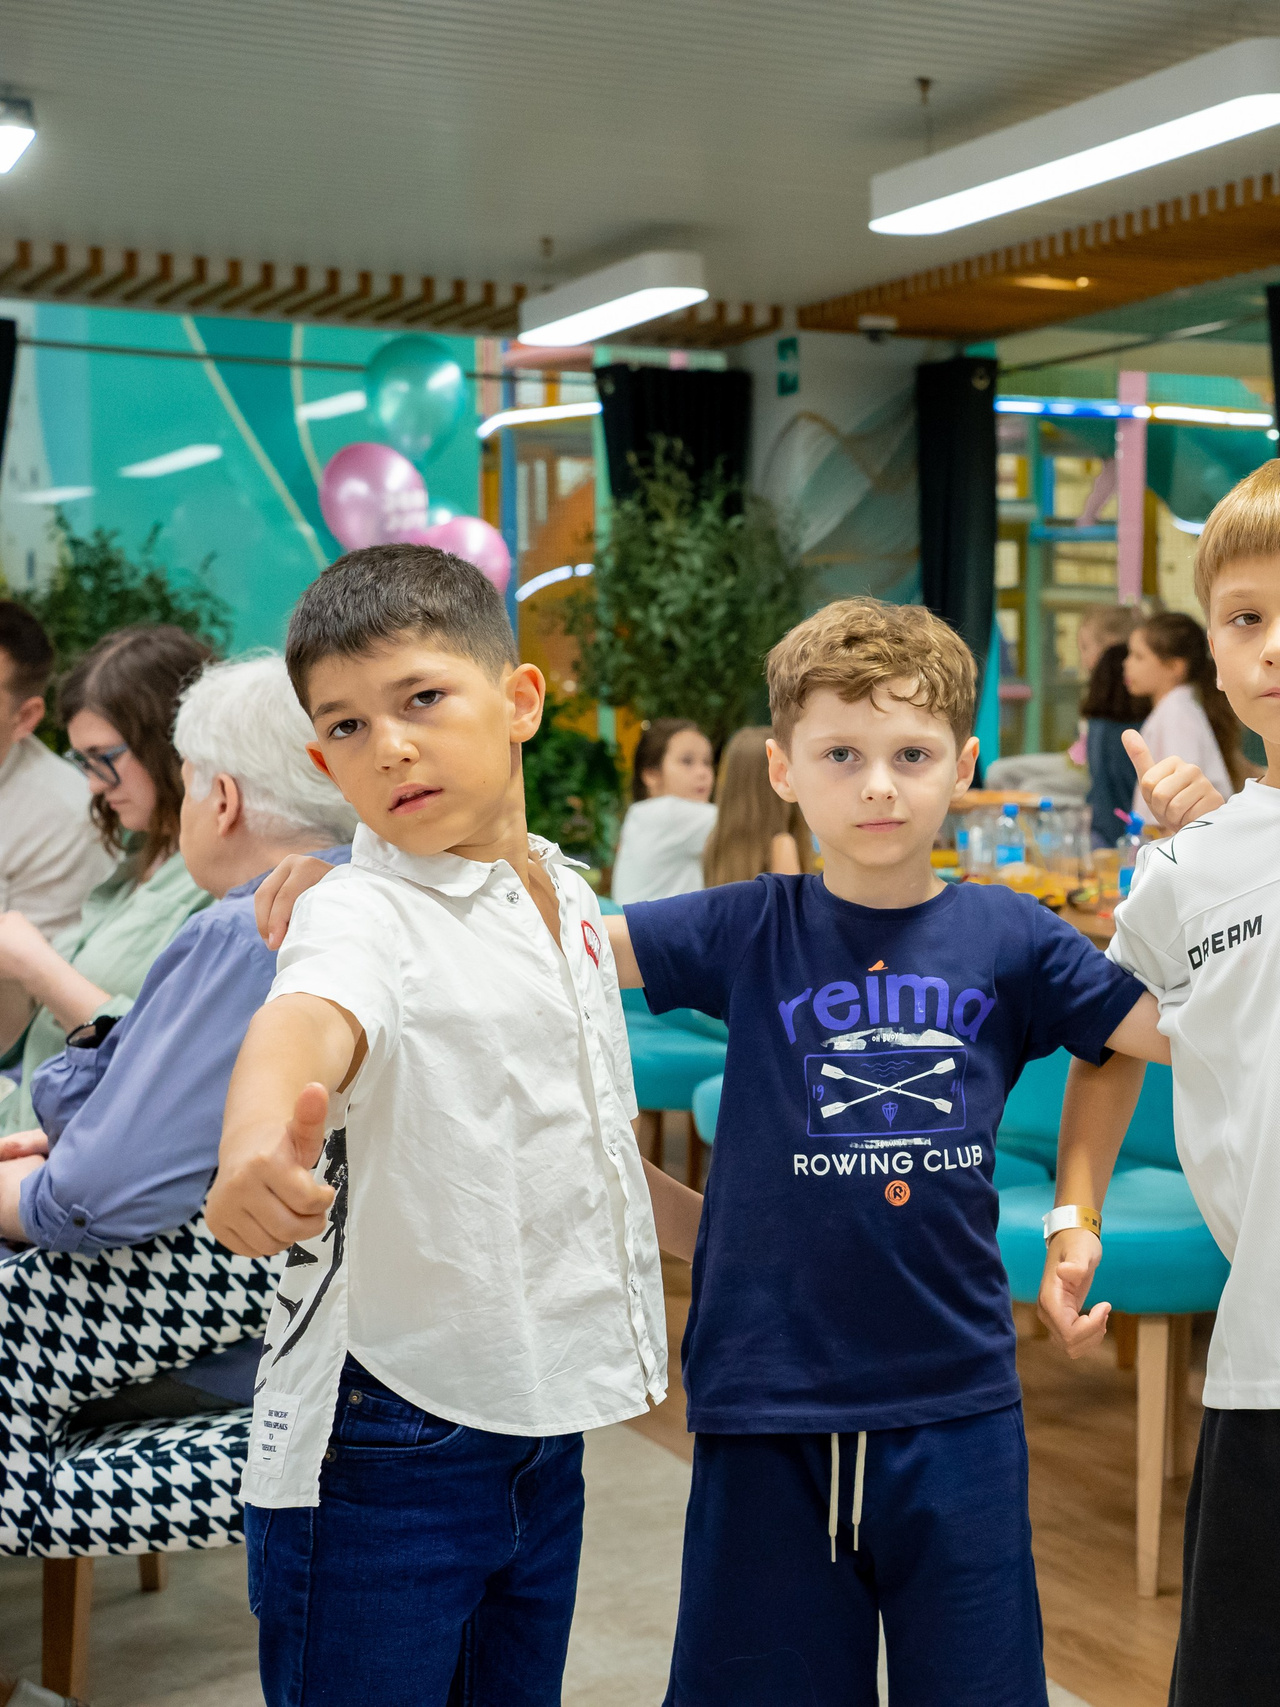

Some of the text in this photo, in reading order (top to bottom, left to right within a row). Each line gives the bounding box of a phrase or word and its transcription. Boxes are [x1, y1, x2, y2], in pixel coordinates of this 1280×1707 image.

[1187, 914, 1262, 971] DREAM
[777, 973, 997, 1045] reima
[793, 1145, 983, 1176] ROWING CLUB
